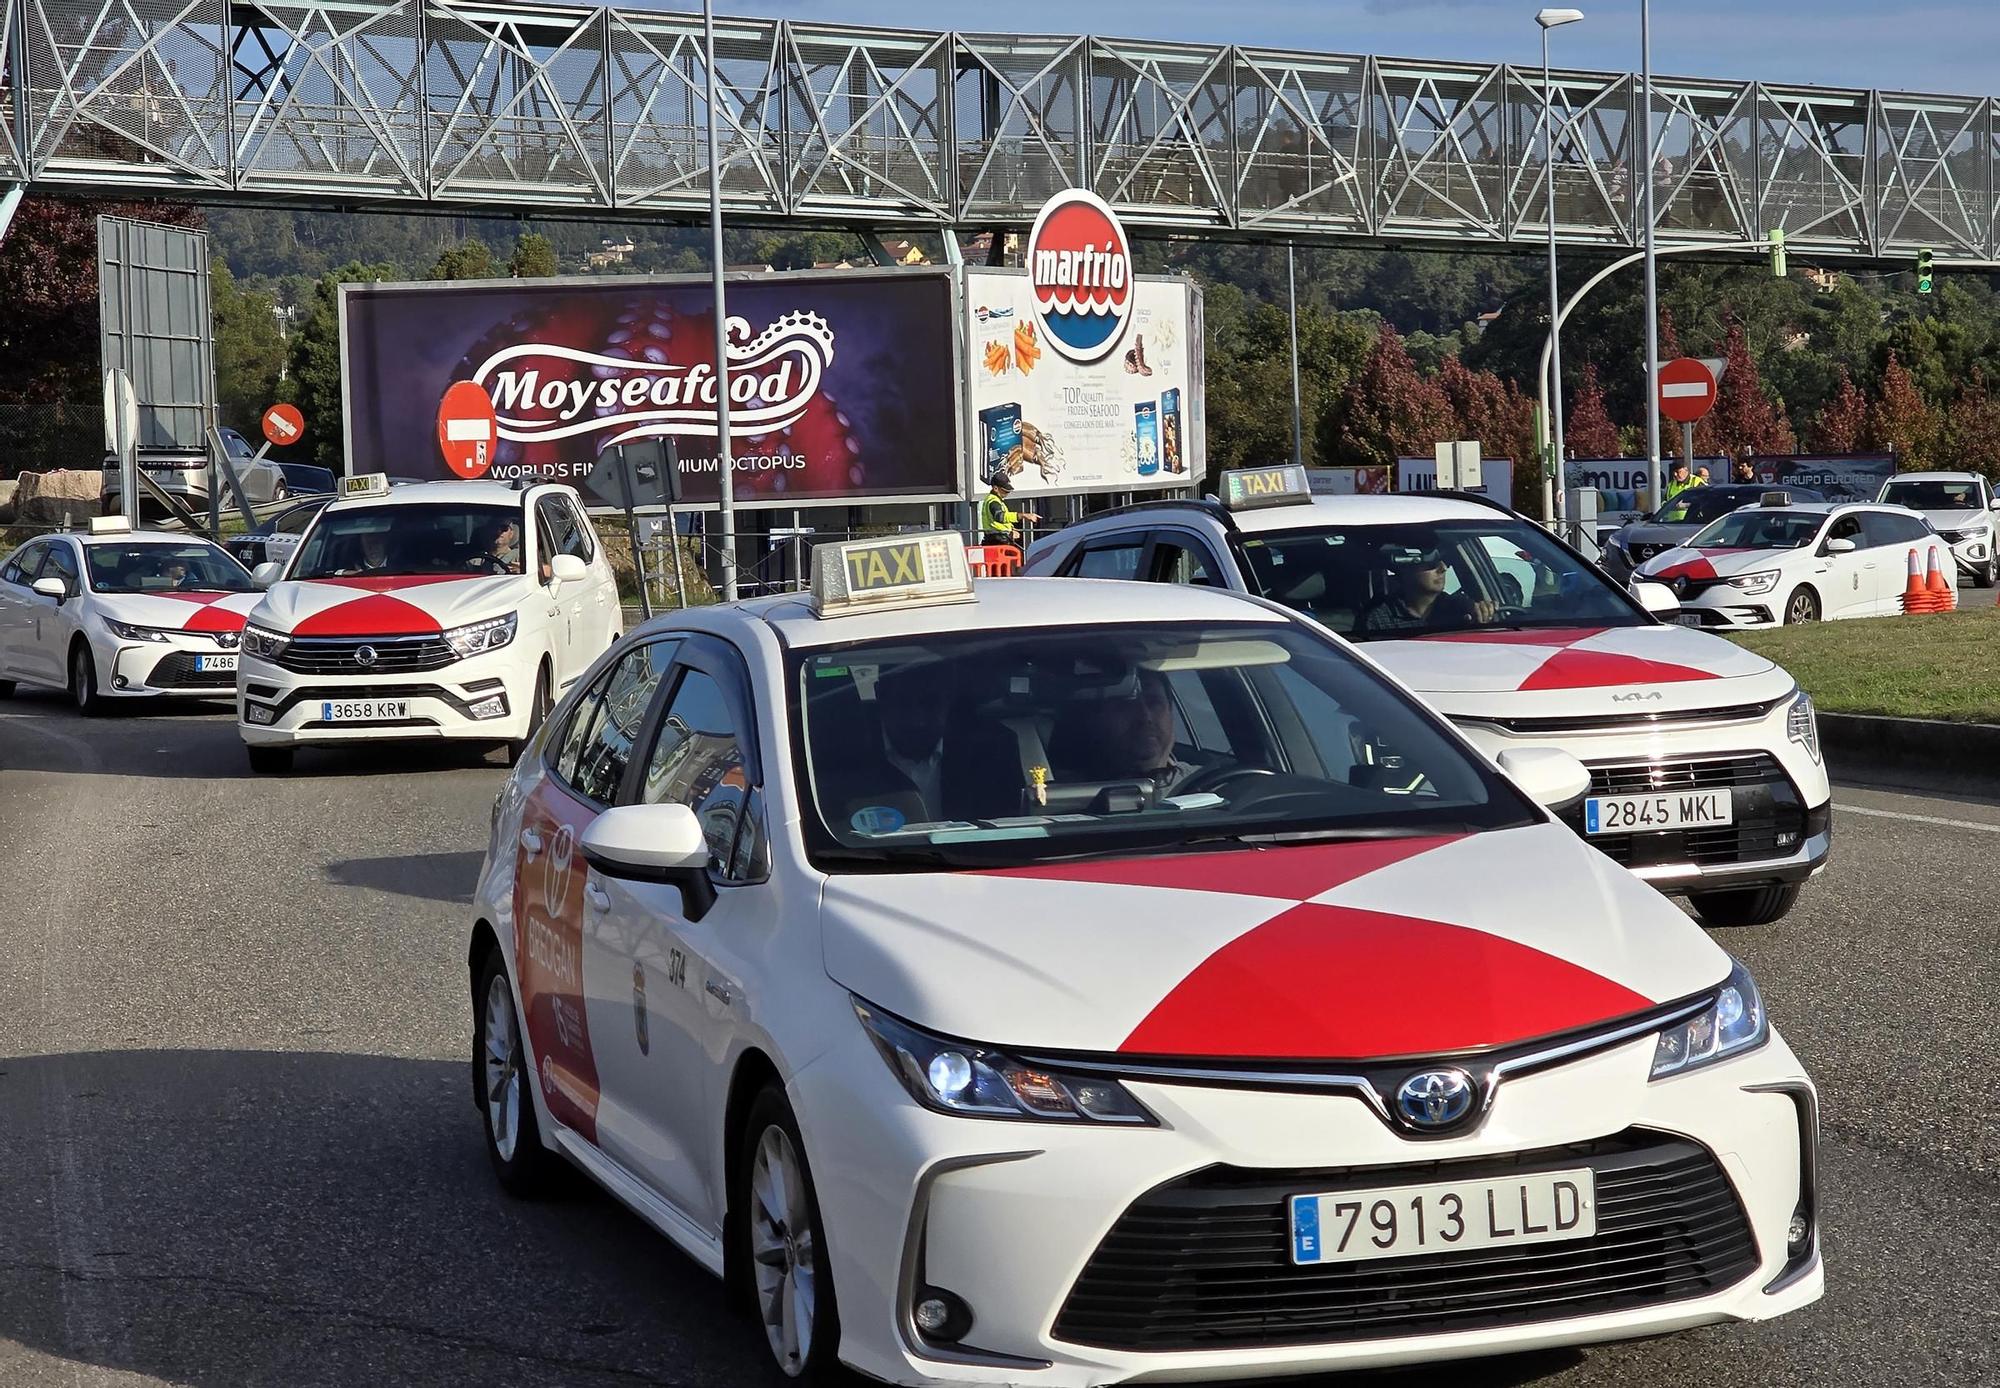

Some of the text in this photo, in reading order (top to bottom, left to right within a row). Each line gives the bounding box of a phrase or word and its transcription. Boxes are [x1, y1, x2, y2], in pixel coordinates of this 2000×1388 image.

[1035, 242, 1126, 289] marfrío
[491, 361, 793, 420] Moyseafood
[1062, 387, 1081, 404] TOP
[1081, 393, 1104, 405] QUALITY
[1067, 404, 1120, 417] FROZEN SEAFOOD
[490, 463, 569, 479] WORLD'S
[1782, 475, 1821, 485] GRUPO
[346, 478, 369, 491] TAXI
[1242, 471, 1285, 495] TAXI
[847, 545, 924, 588] TAXI
[204, 657, 235, 669] 7486
[334, 702, 407, 718] 3658 KRW
[1606, 799, 1670, 828] 2845
[1680, 796, 1726, 823] MKL
[669, 947, 686, 989] 374
[1302, 1181, 1581, 1254] E 7913 LLD
